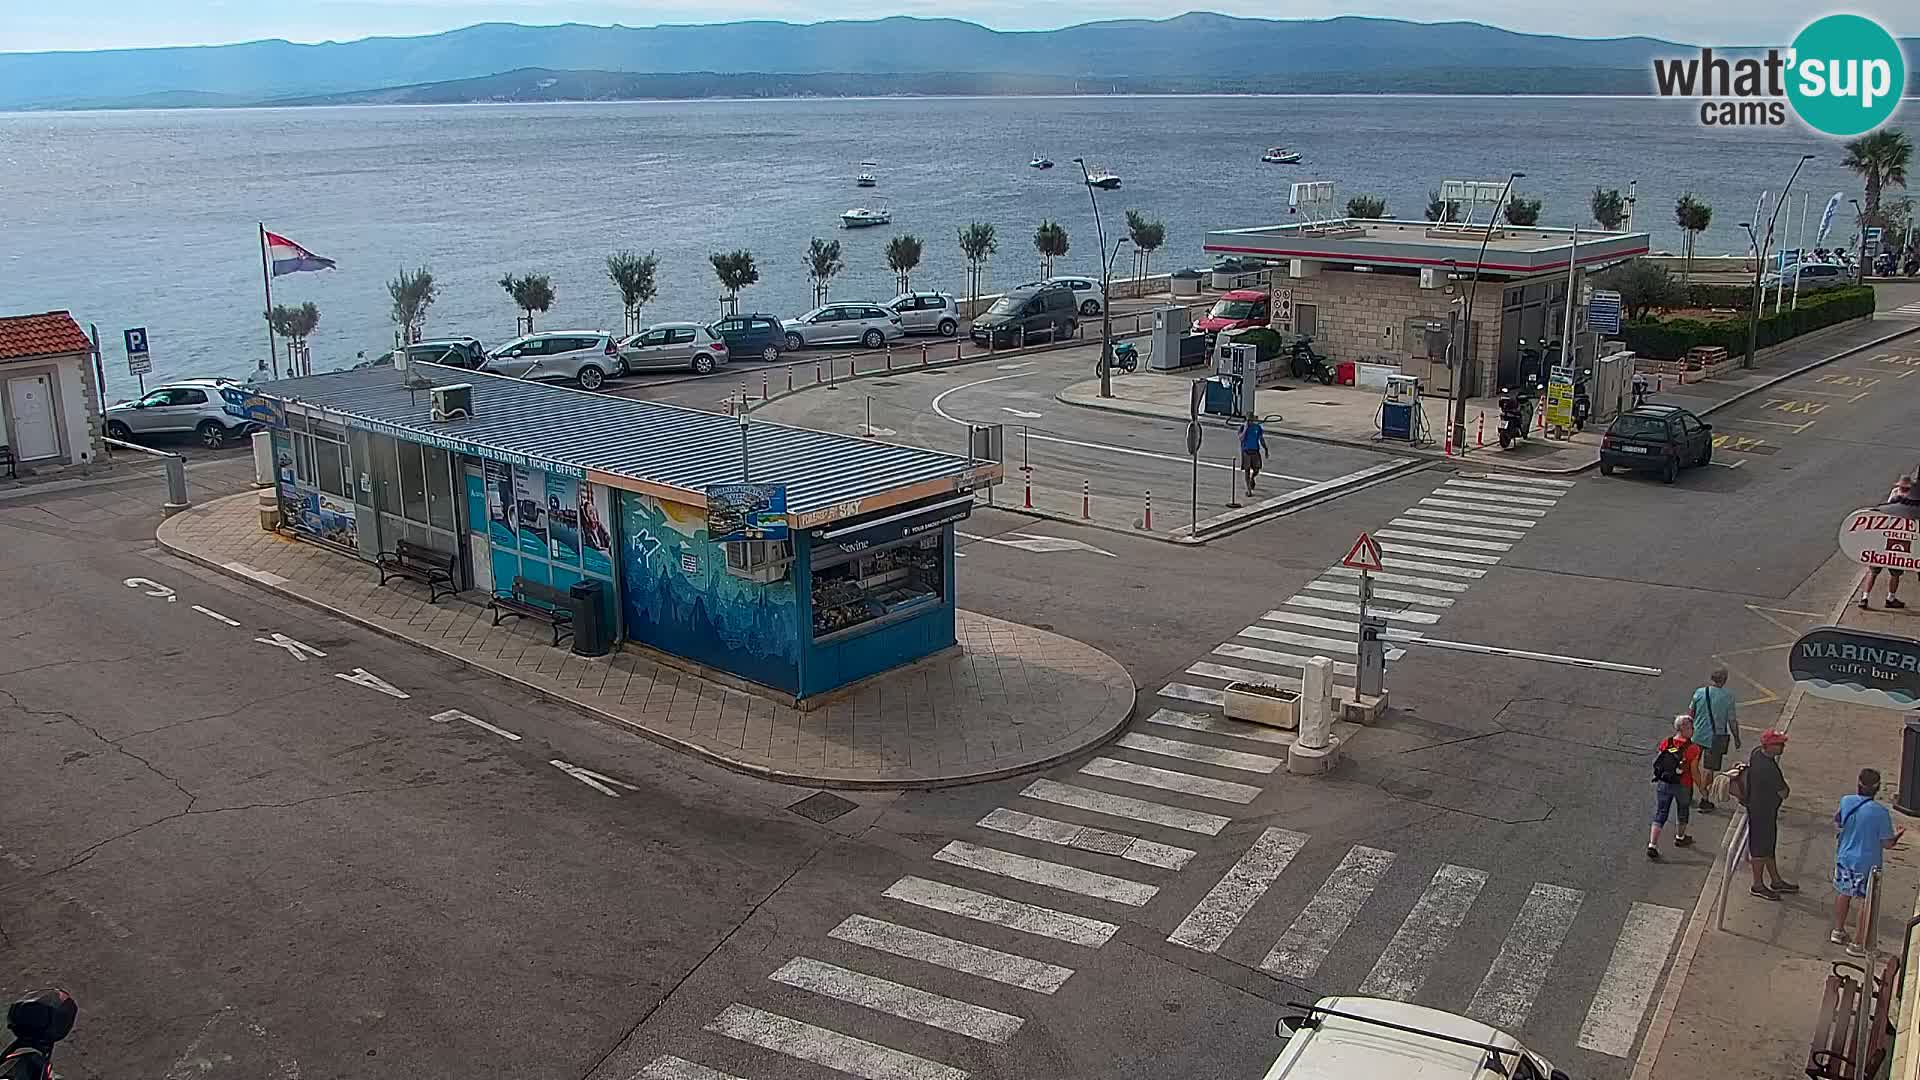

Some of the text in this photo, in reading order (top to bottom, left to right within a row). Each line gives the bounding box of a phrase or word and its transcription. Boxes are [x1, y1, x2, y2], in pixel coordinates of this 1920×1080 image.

[1815, 374, 1881, 388] TAXI
[1760, 398, 1831, 415] TAXI
[1712, 435, 1766, 452] AXI
[395, 428, 436, 446] AUTOBUSNA
[436, 437, 467, 452] POSTAJA
[477, 446, 493, 458] BUS
[493, 451, 526, 466] STATION
[528, 457, 554, 472] TICKET
[555, 464, 582, 478] OFFICE
[839, 500, 863, 518] SKY
[911, 524, 925, 534] YOUR
[1849, 515, 1920, 533] PIZZE
[1883, 530, 1918, 541] GRILL
[839, 538, 869, 554] Novine
[1801, 642, 1920, 673] MARINER
[1829, 662, 1898, 681] caffe bar
